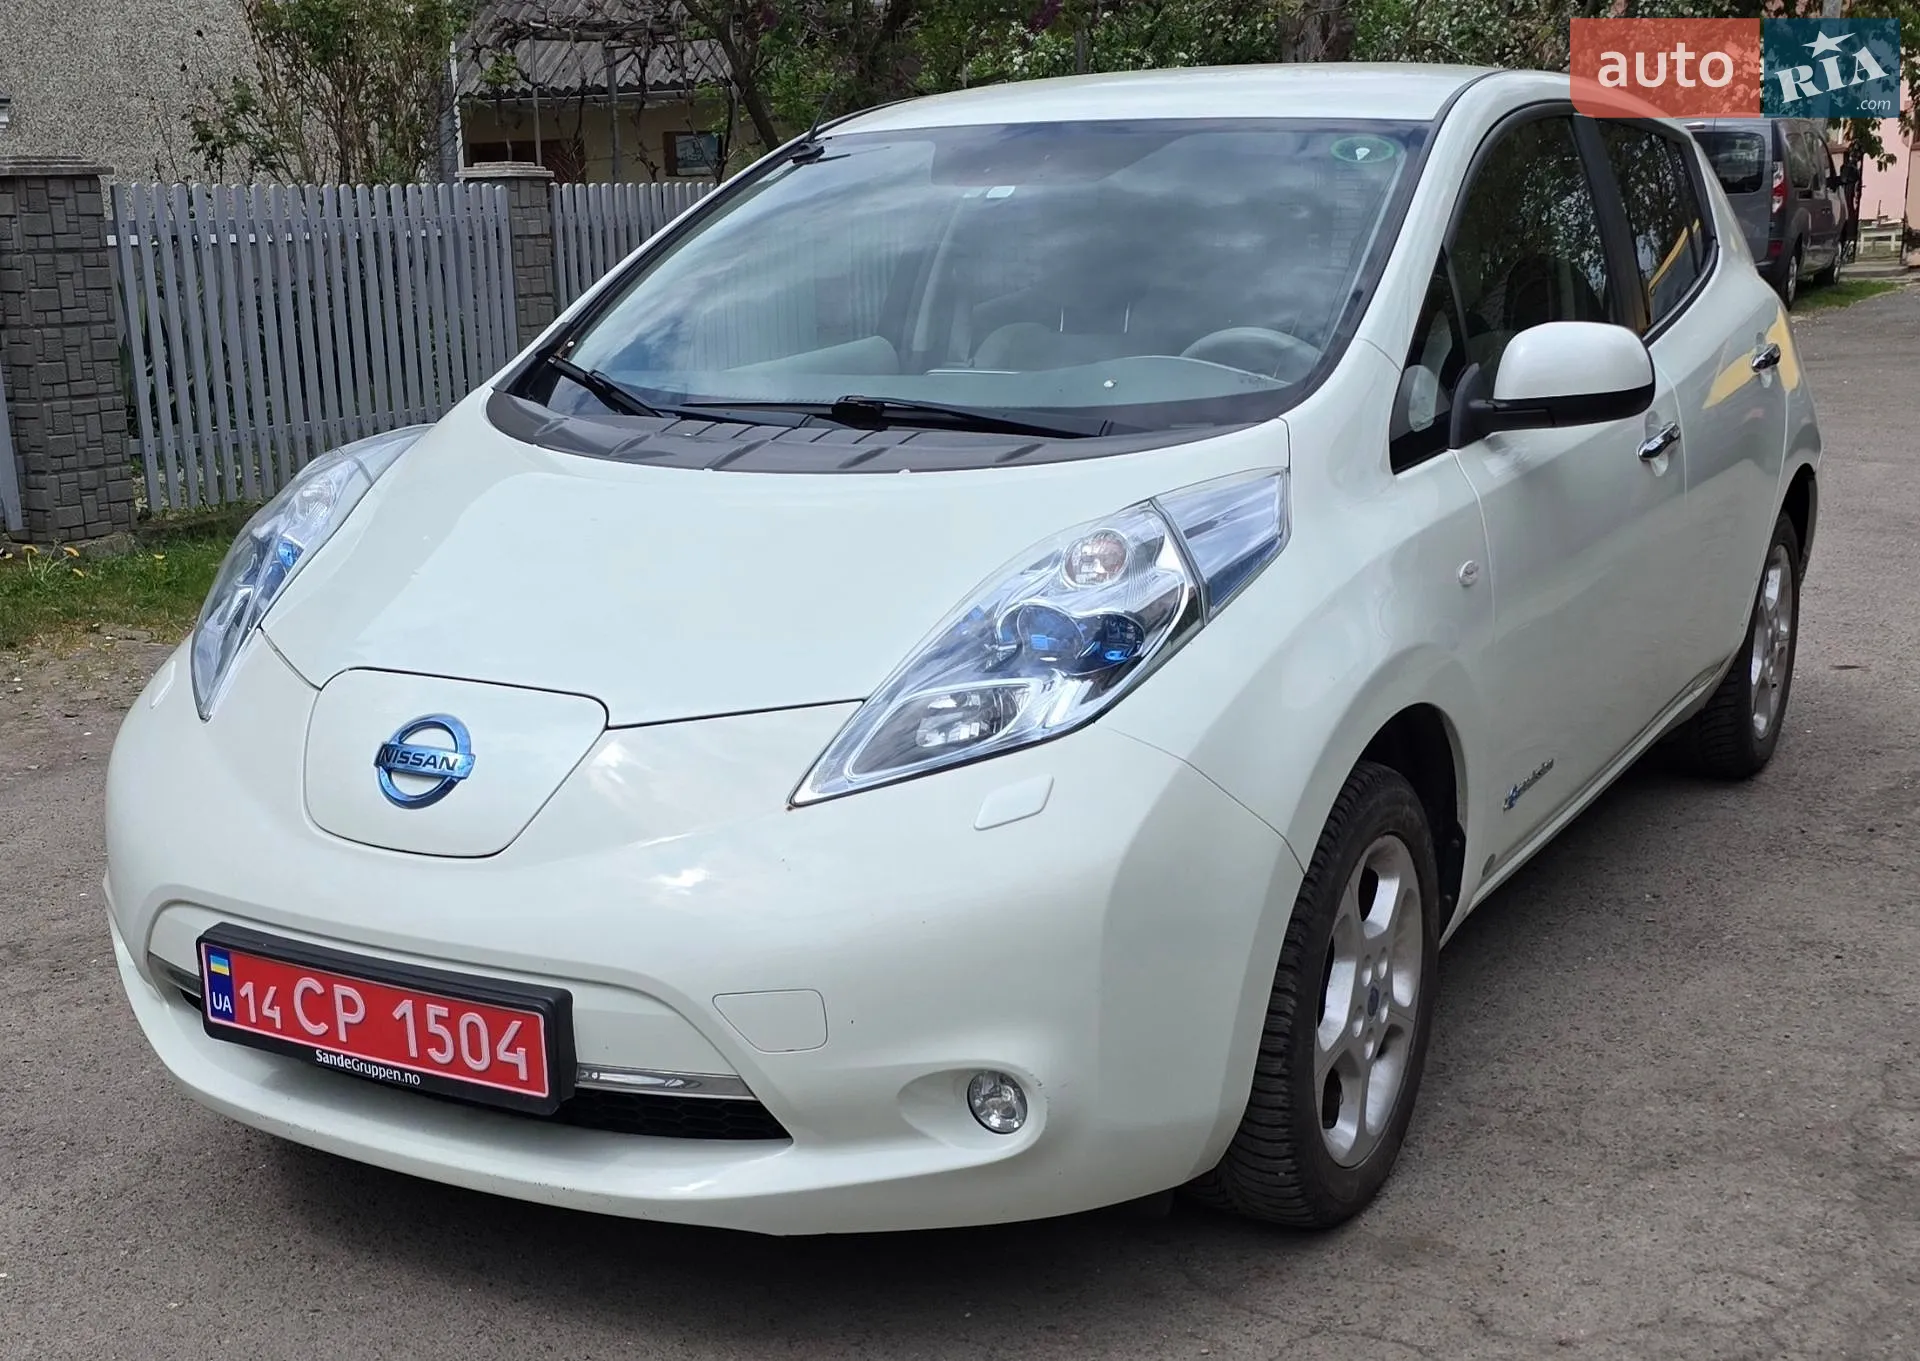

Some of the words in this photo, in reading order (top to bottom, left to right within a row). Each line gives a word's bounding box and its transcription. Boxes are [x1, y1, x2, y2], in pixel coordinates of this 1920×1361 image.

[380, 747, 459, 771] NISSAN
[212, 991, 233, 1015] UA
[239, 981, 282, 1030] 14
[293, 977, 366, 1043] CP
[391, 999, 528, 1081] 1504
[315, 1048, 421, 1086] SandeGruppen.no
